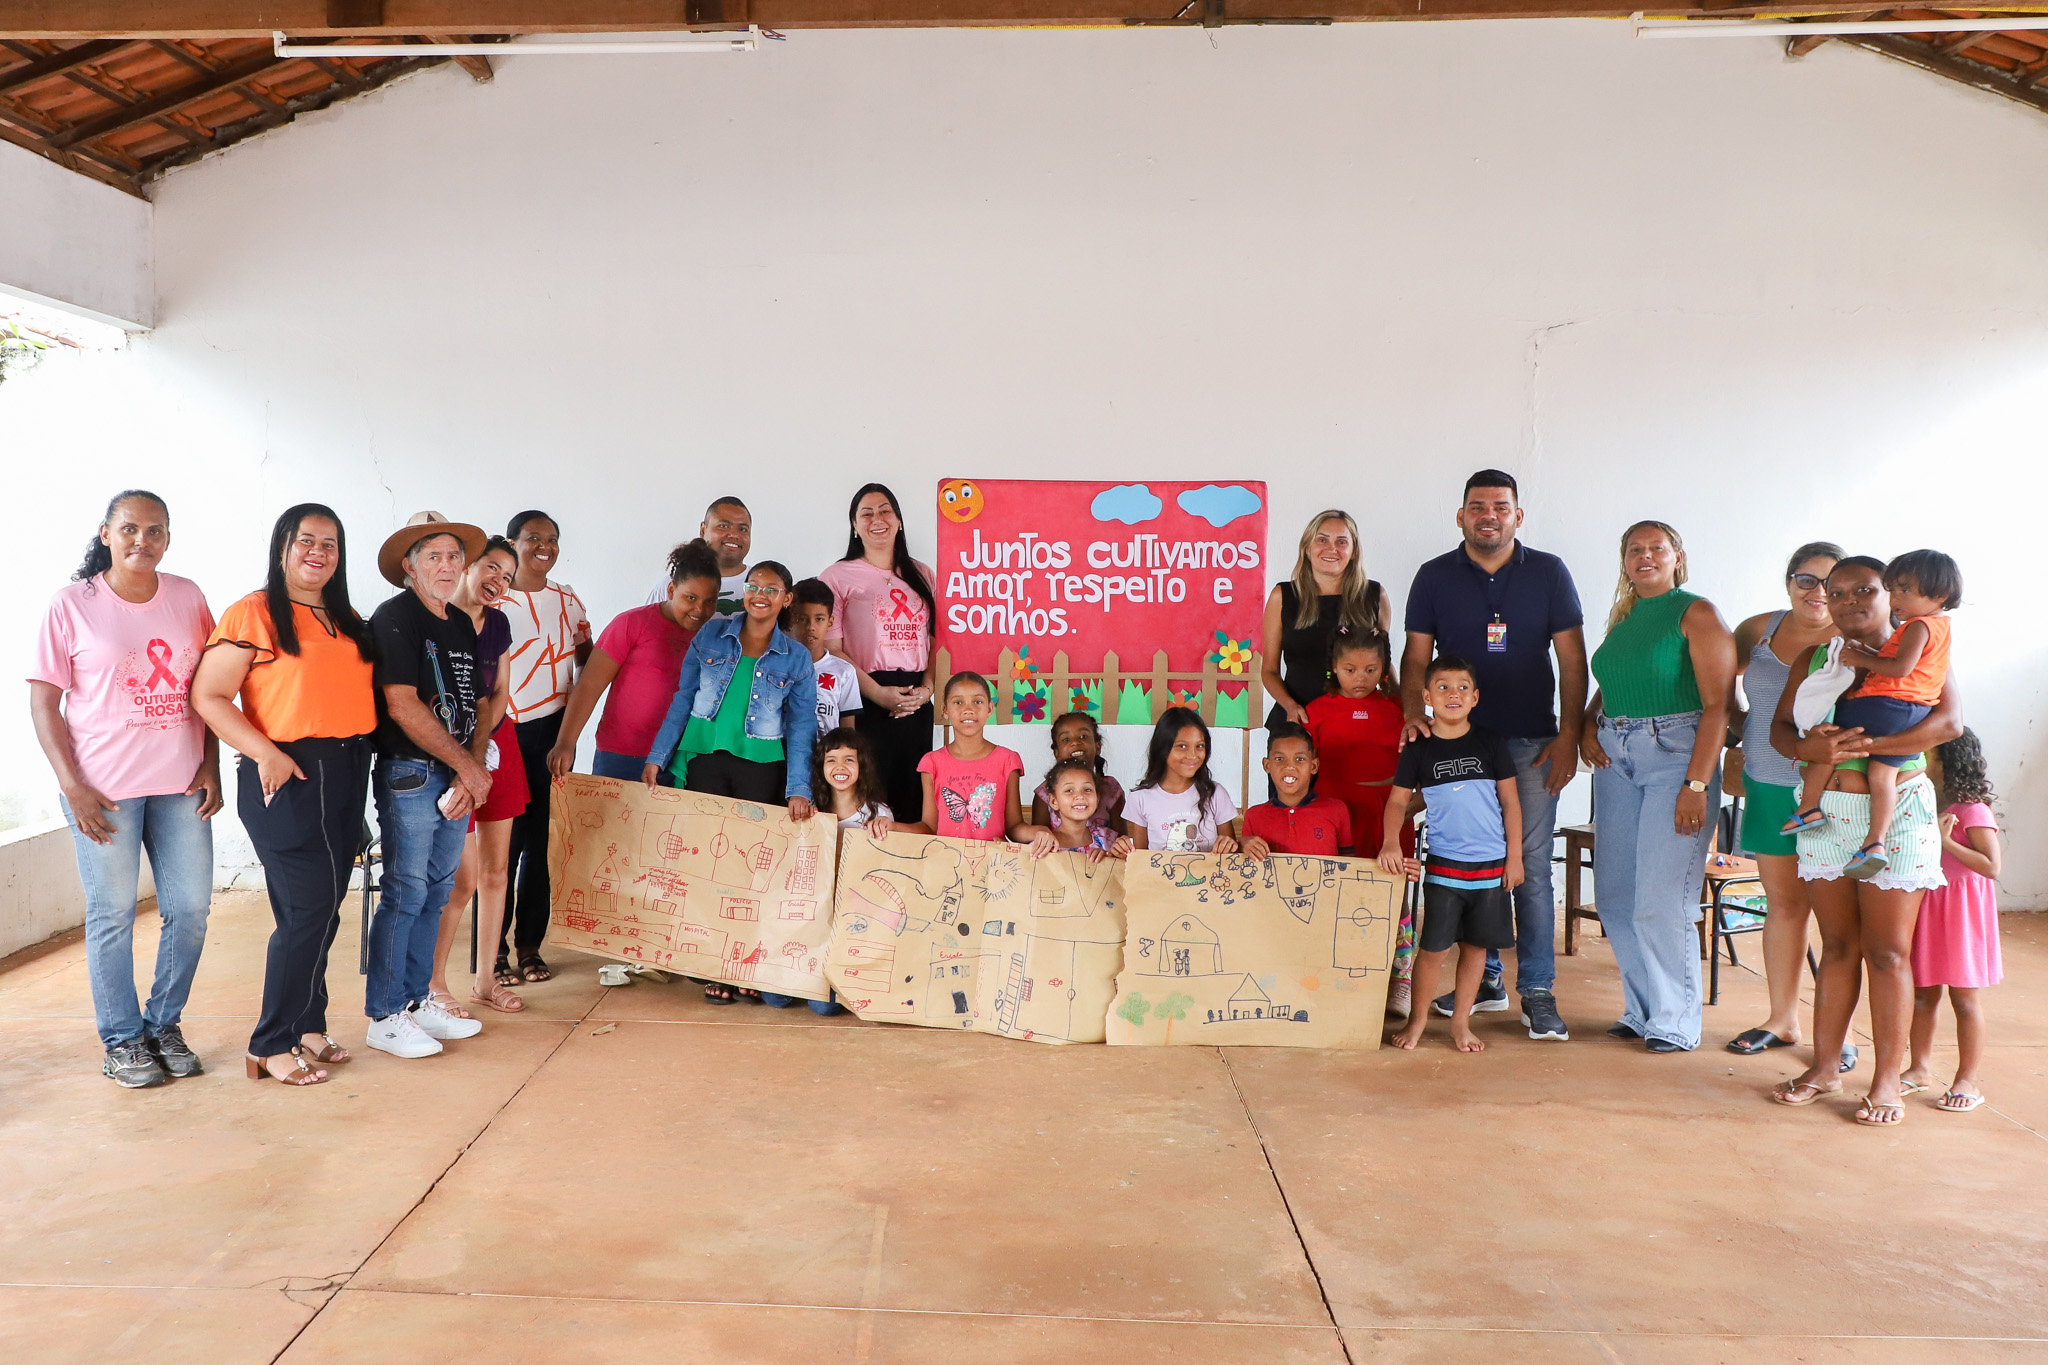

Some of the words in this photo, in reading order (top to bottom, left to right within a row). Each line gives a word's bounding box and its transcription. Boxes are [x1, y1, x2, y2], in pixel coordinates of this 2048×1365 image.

[1213, 577, 1232, 604] e
[948, 596, 1077, 636] sonhos.
[883, 623, 921, 631] OUTUBRO
[890, 632, 918, 640] ROSA
[134, 692, 188, 705] OUTUBRO
[145, 703, 184, 717] ROSA
[1433, 757, 1483, 779] AIR
